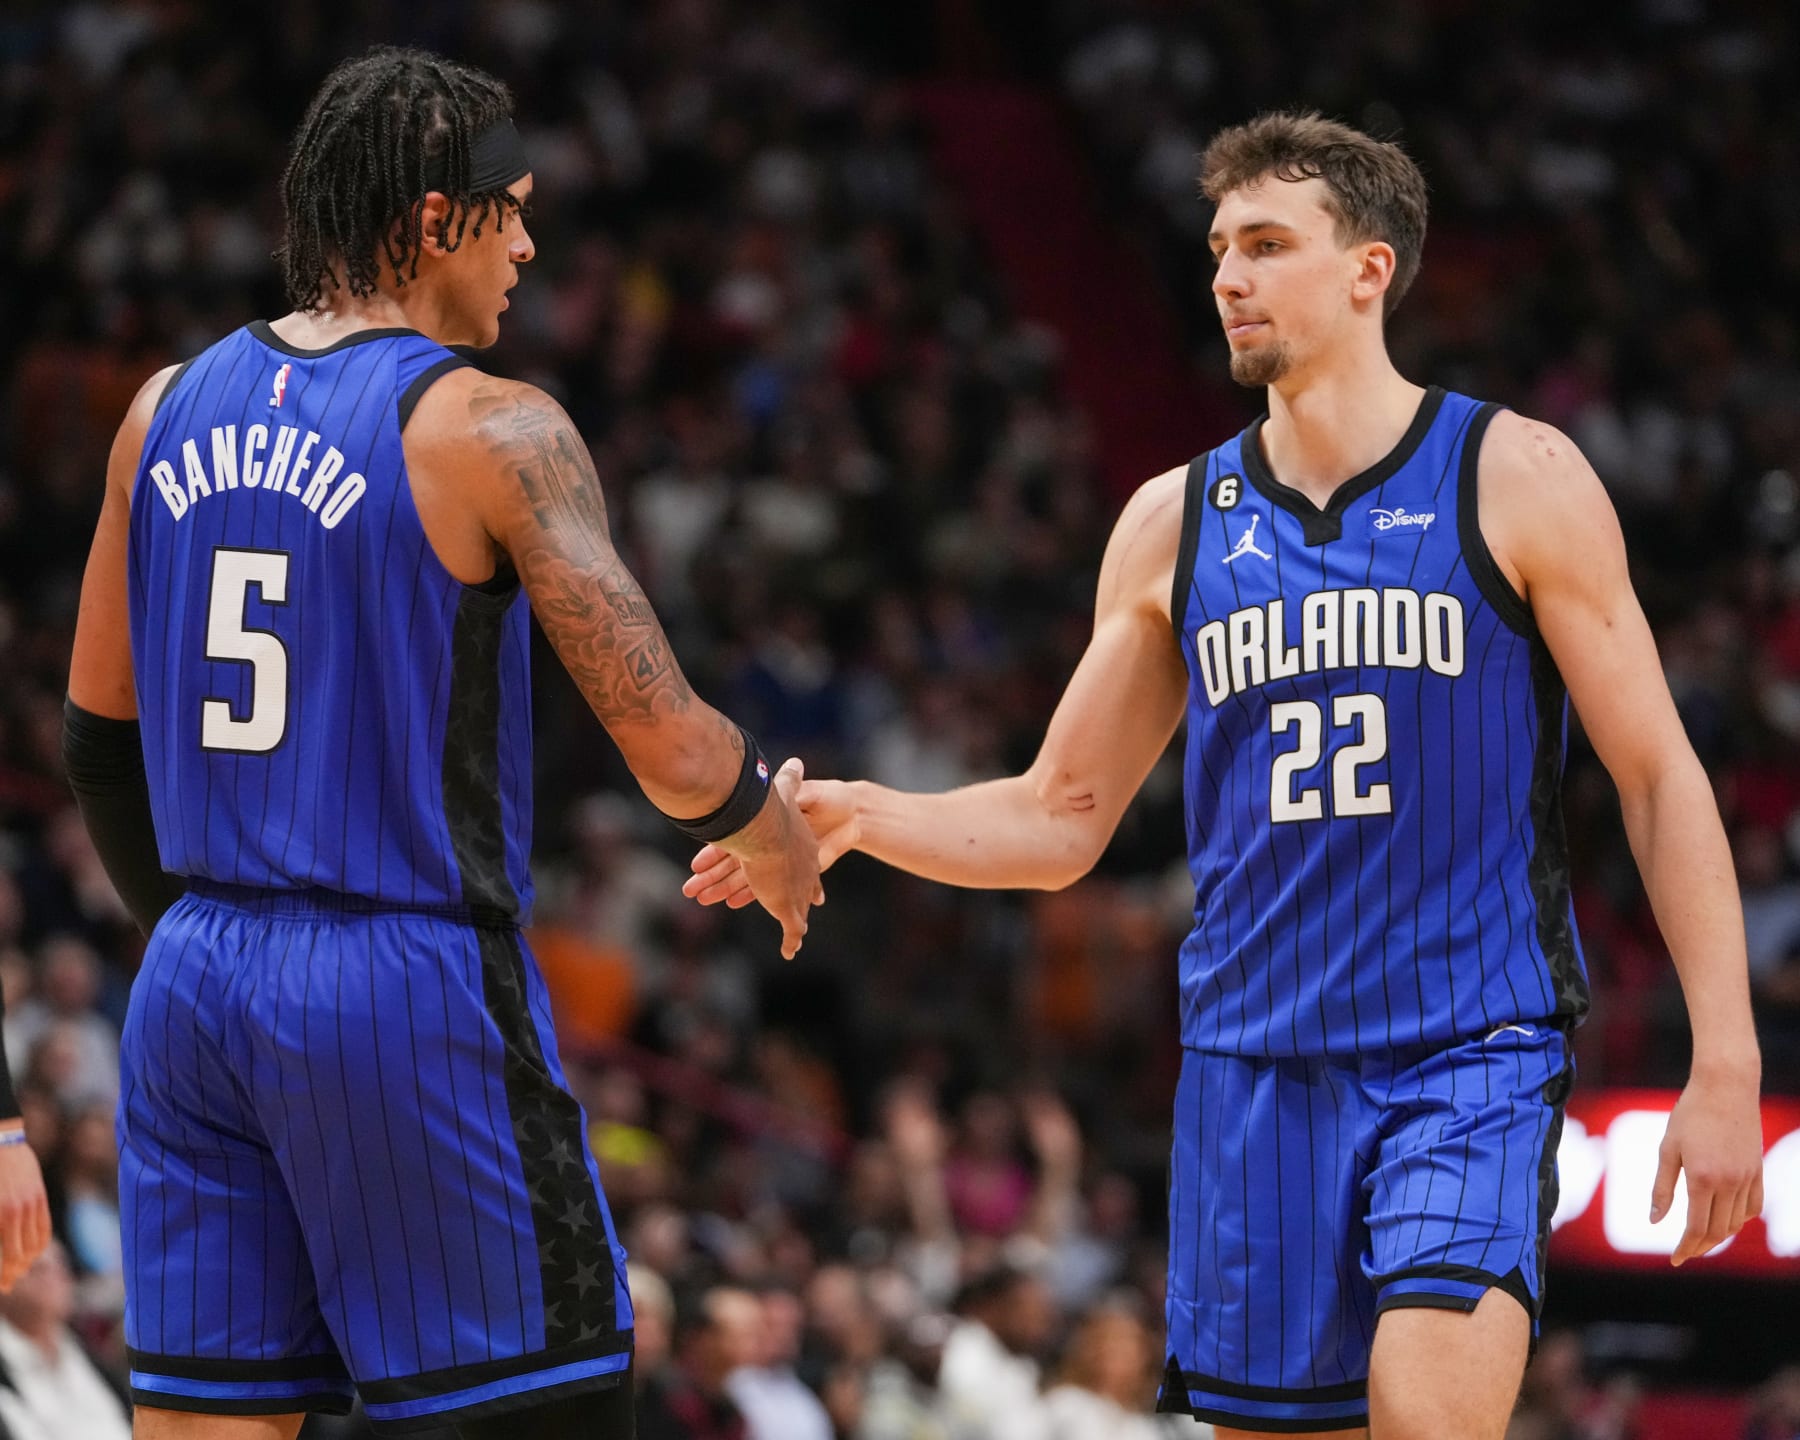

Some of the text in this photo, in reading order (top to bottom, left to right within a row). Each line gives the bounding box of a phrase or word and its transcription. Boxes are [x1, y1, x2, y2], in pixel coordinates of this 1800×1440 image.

[149, 423, 367, 530] BANCHERO
[1216, 477, 1238, 508] 6
[201, 545, 290, 755] 5
[1196, 587, 1464, 708] ORLANDO
[1270, 693, 1393, 824] 22
